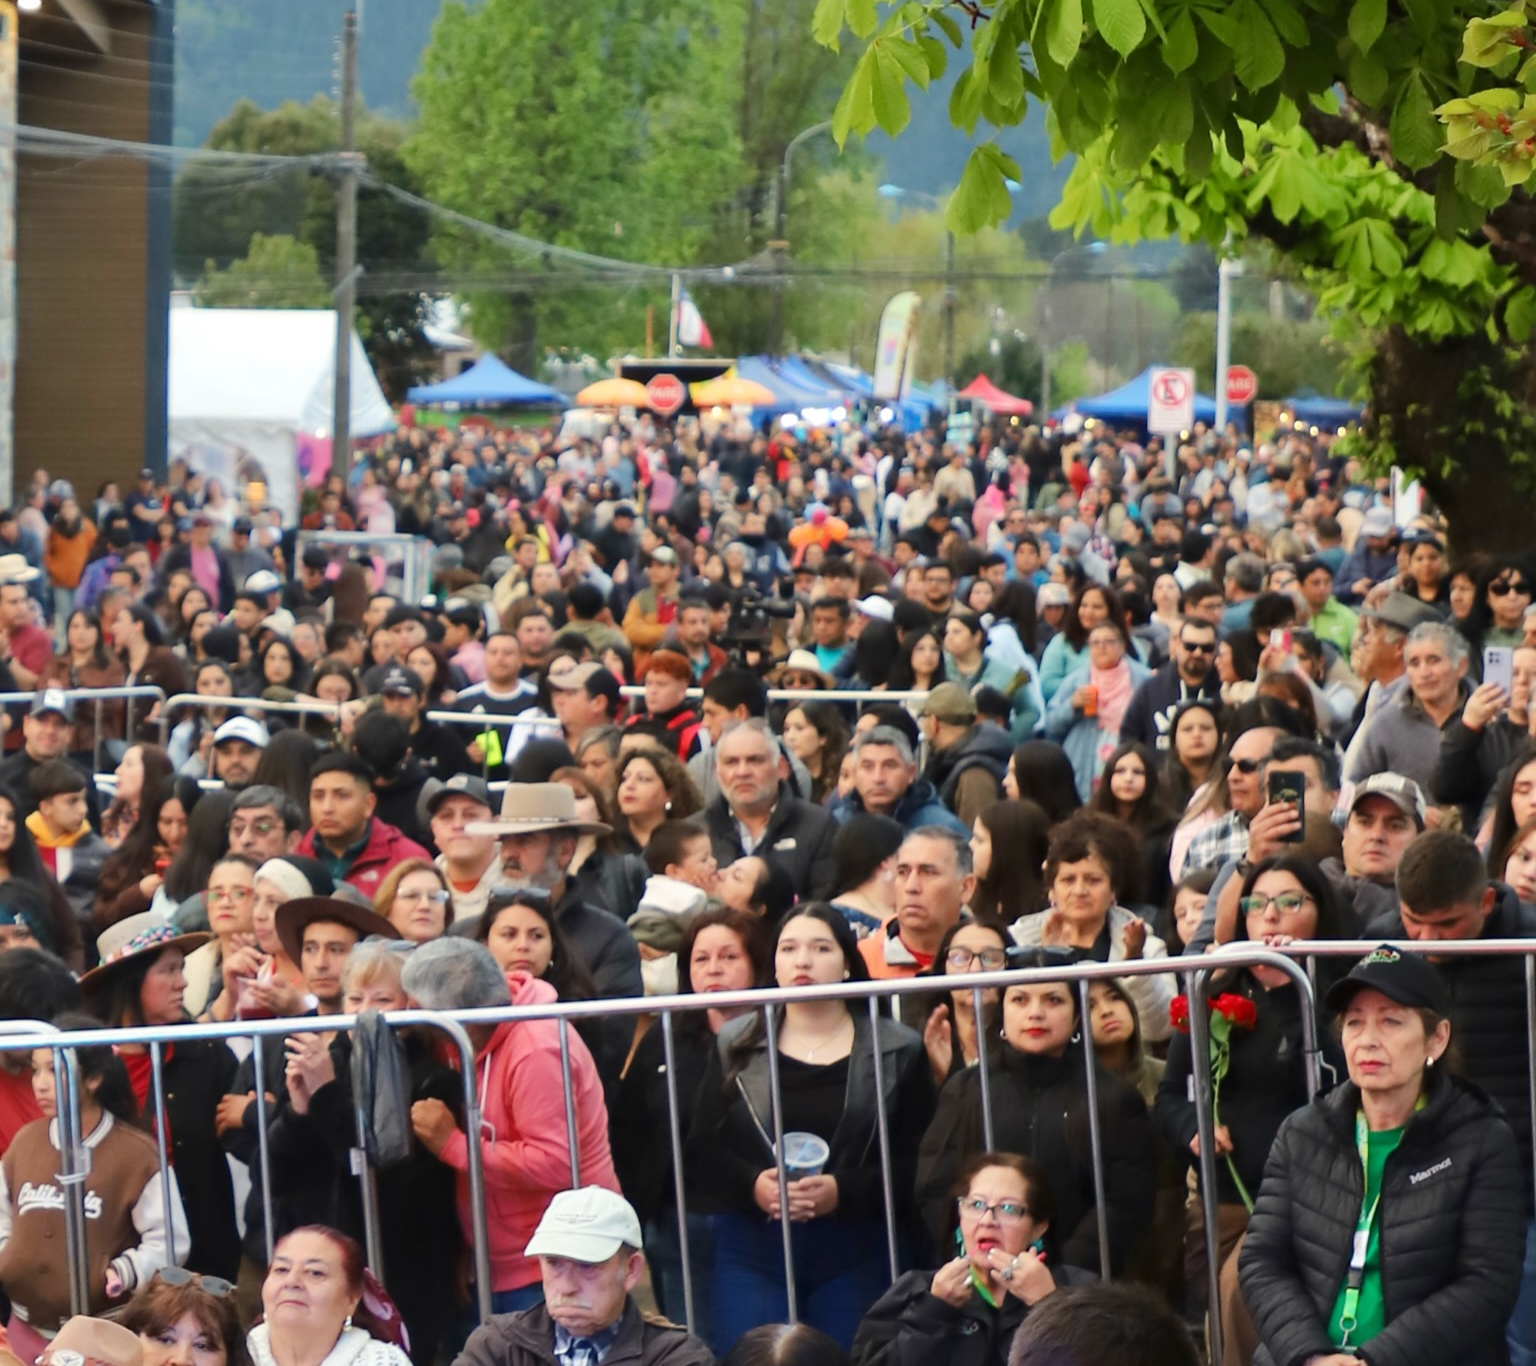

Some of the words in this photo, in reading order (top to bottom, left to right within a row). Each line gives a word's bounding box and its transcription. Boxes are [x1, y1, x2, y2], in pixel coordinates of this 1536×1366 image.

[648, 386, 680, 399] PARE
[1226, 378, 1252, 391] ARE
[1408, 1156, 1453, 1185] Marmot
[18, 1181, 103, 1219] Califoia
